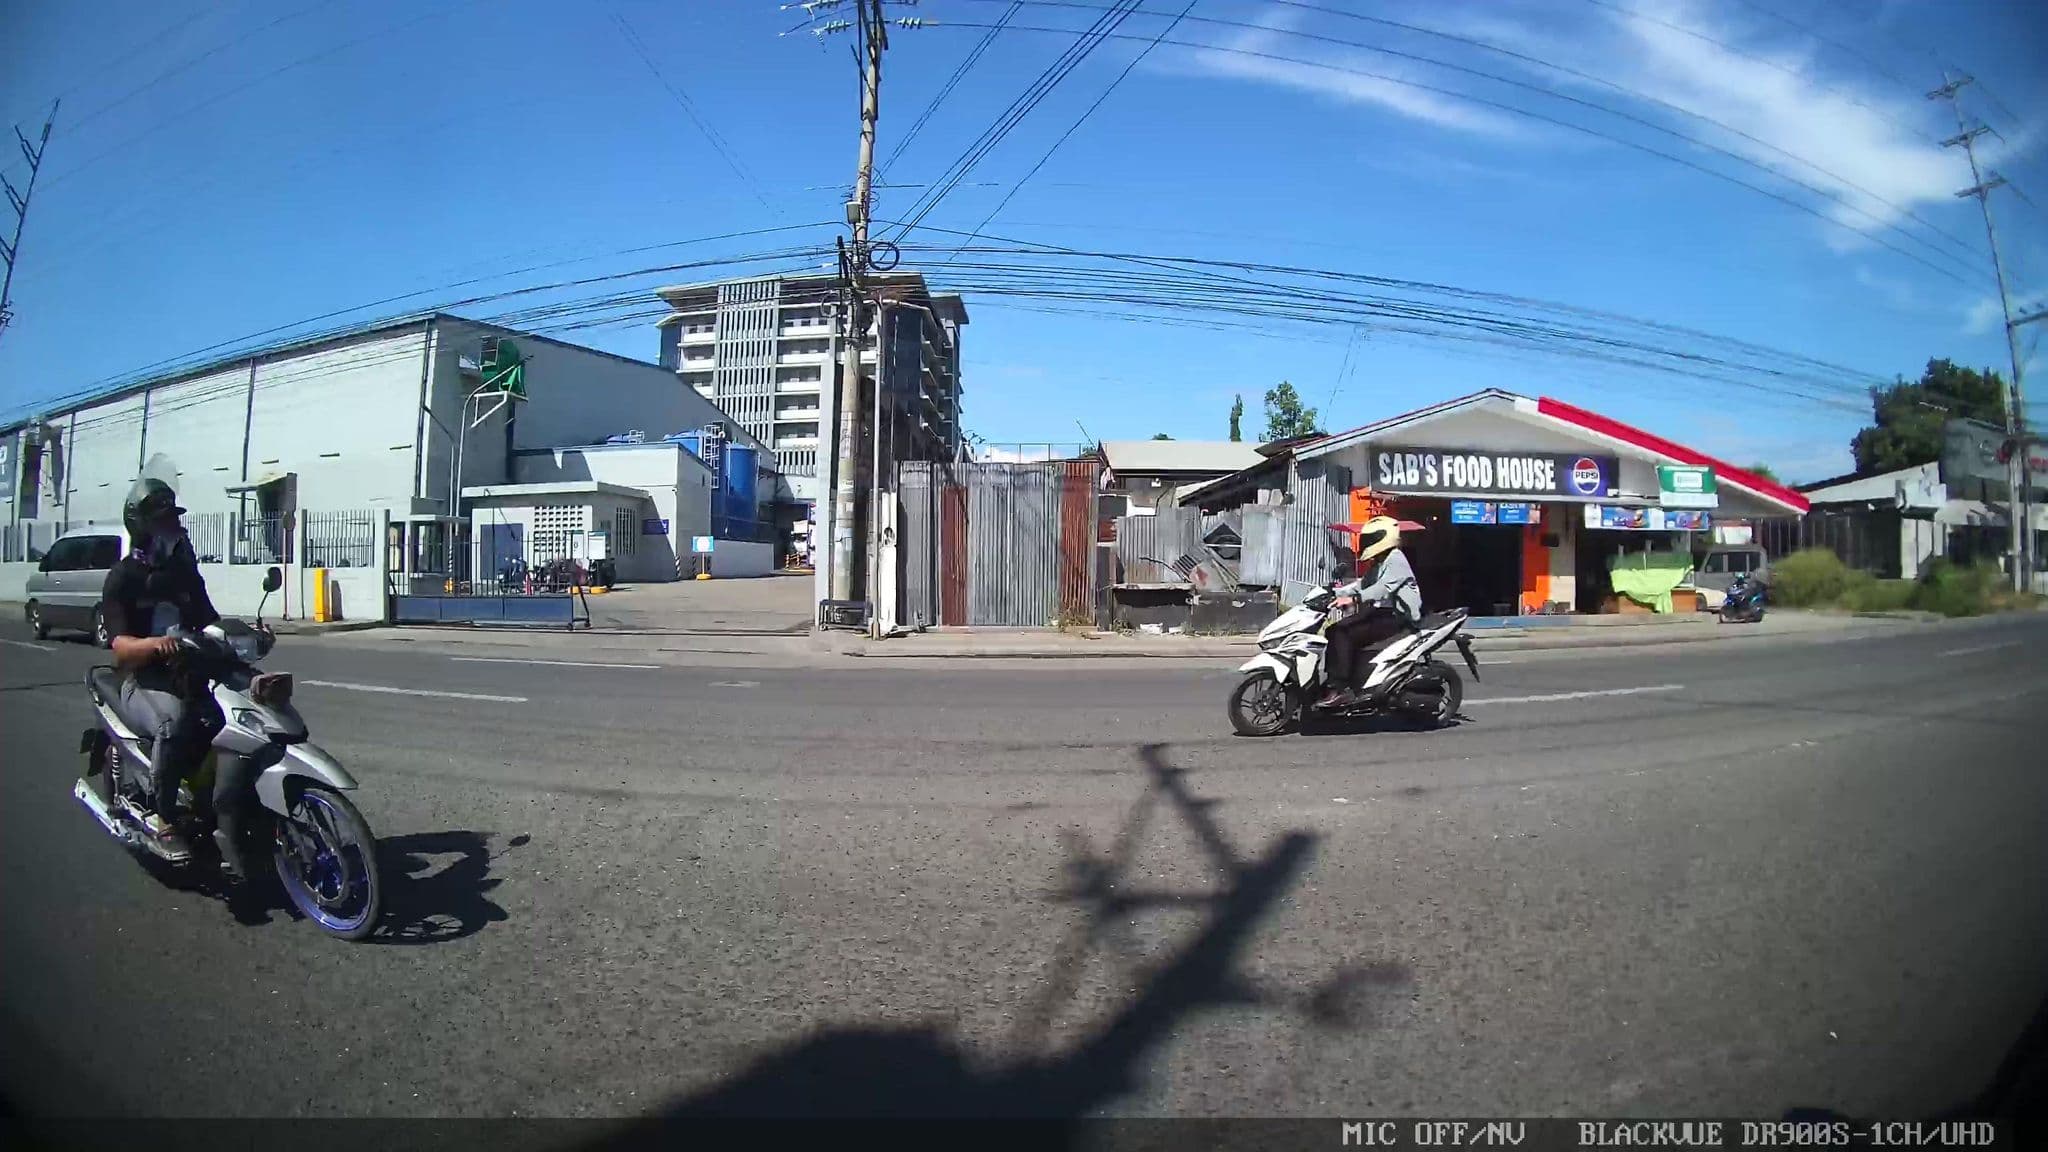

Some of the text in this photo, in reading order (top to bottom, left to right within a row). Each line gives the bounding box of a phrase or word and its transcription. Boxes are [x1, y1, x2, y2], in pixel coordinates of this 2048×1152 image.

[1379, 452, 1556, 490] SAB'S FOOD HOUSE
[1575, 470, 1599, 480] PEPSI
